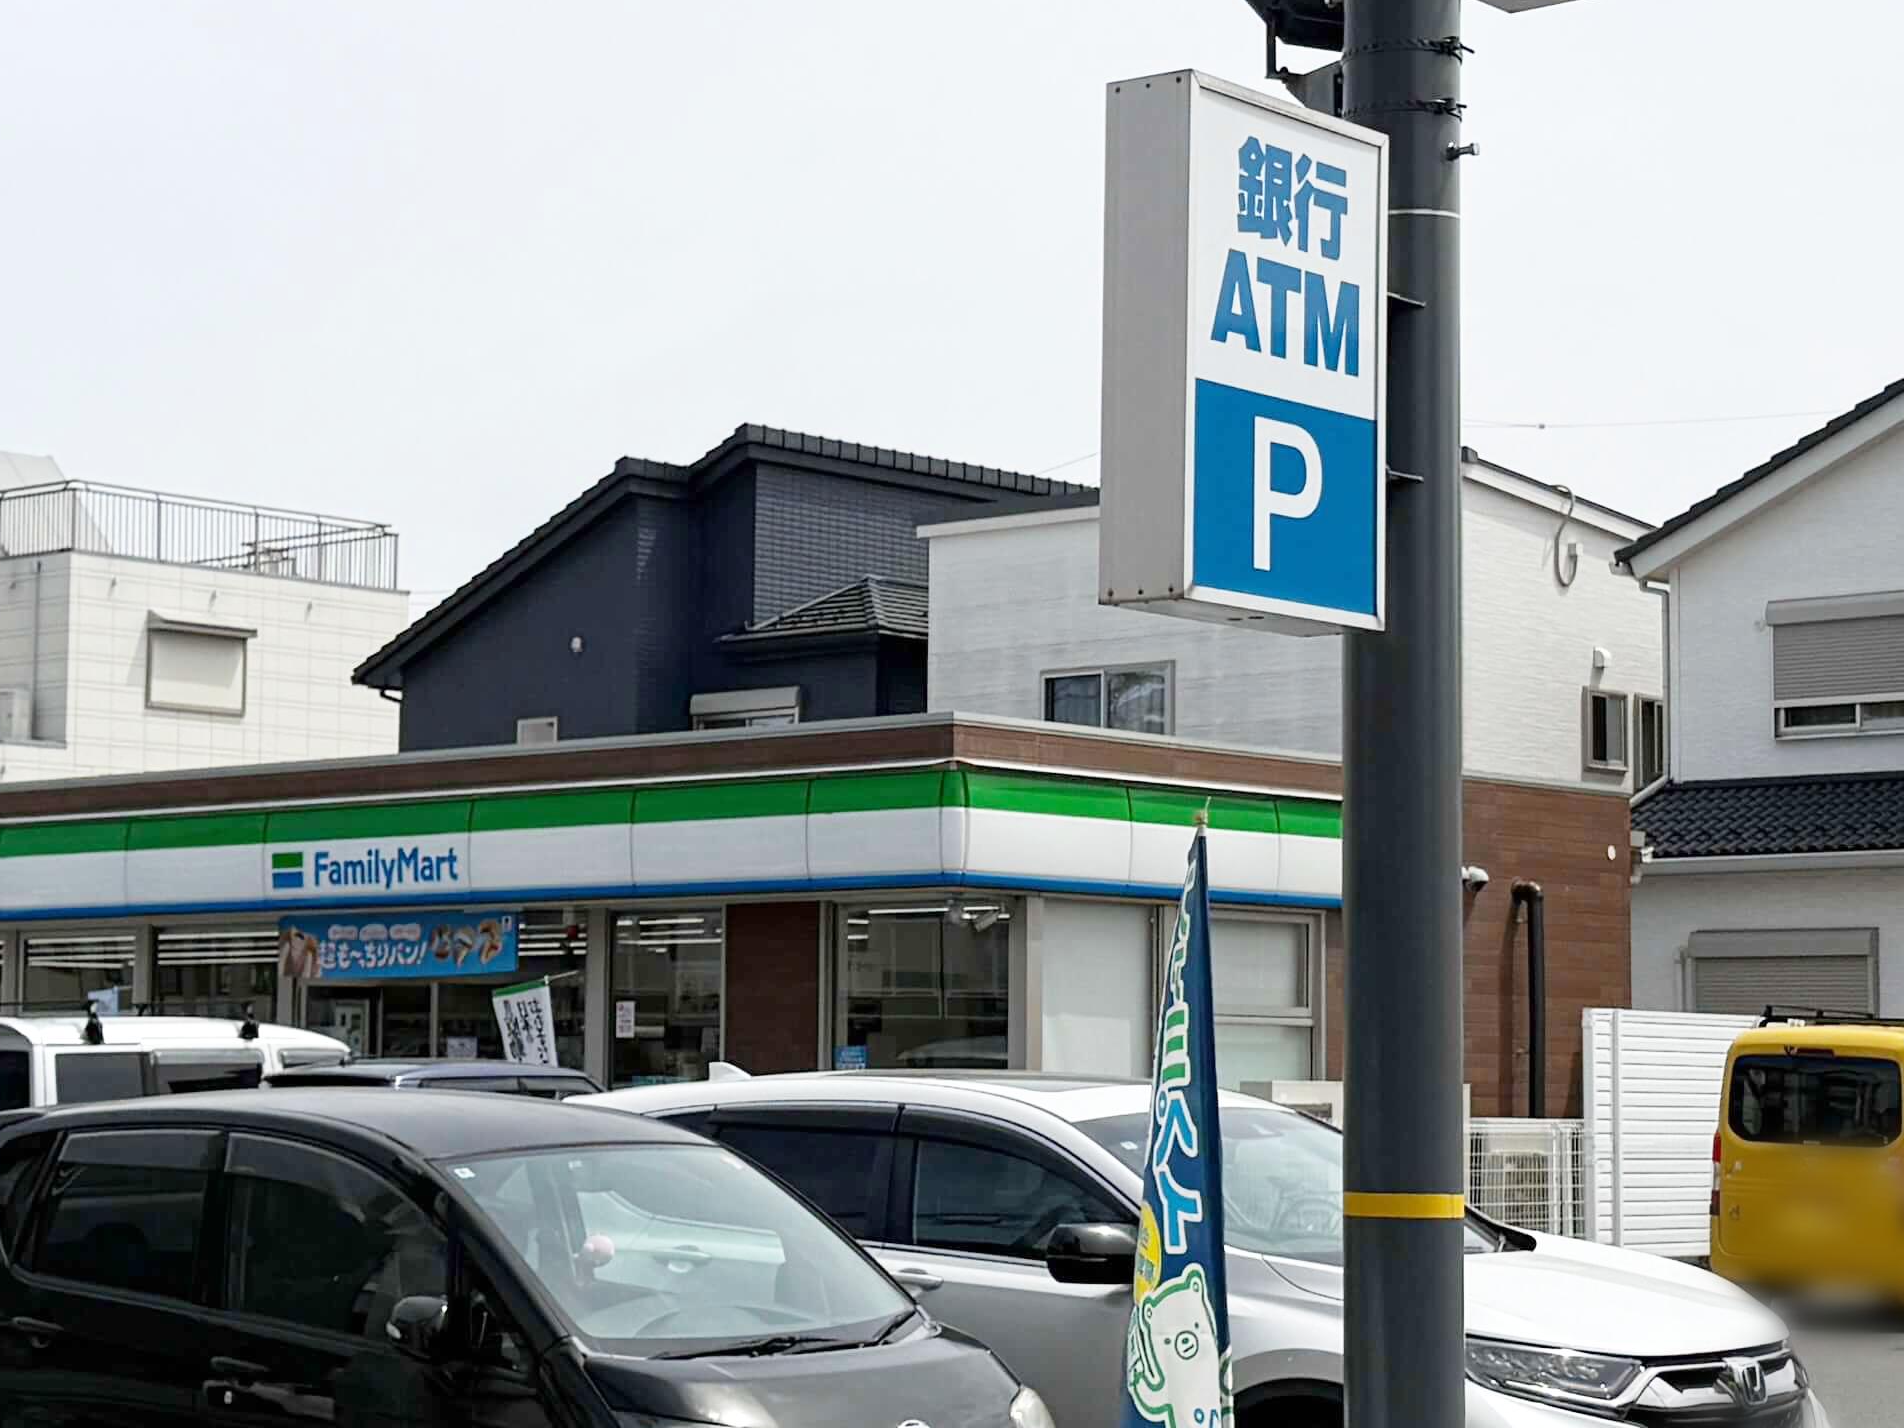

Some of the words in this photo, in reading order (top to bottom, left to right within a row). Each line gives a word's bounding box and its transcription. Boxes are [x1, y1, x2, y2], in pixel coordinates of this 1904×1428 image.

[1237, 135, 1348, 261] 銀行
[1210, 248, 1360, 377] ATM
[1252, 414, 1324, 572] P
[313, 847, 459, 889] FamilyMart
